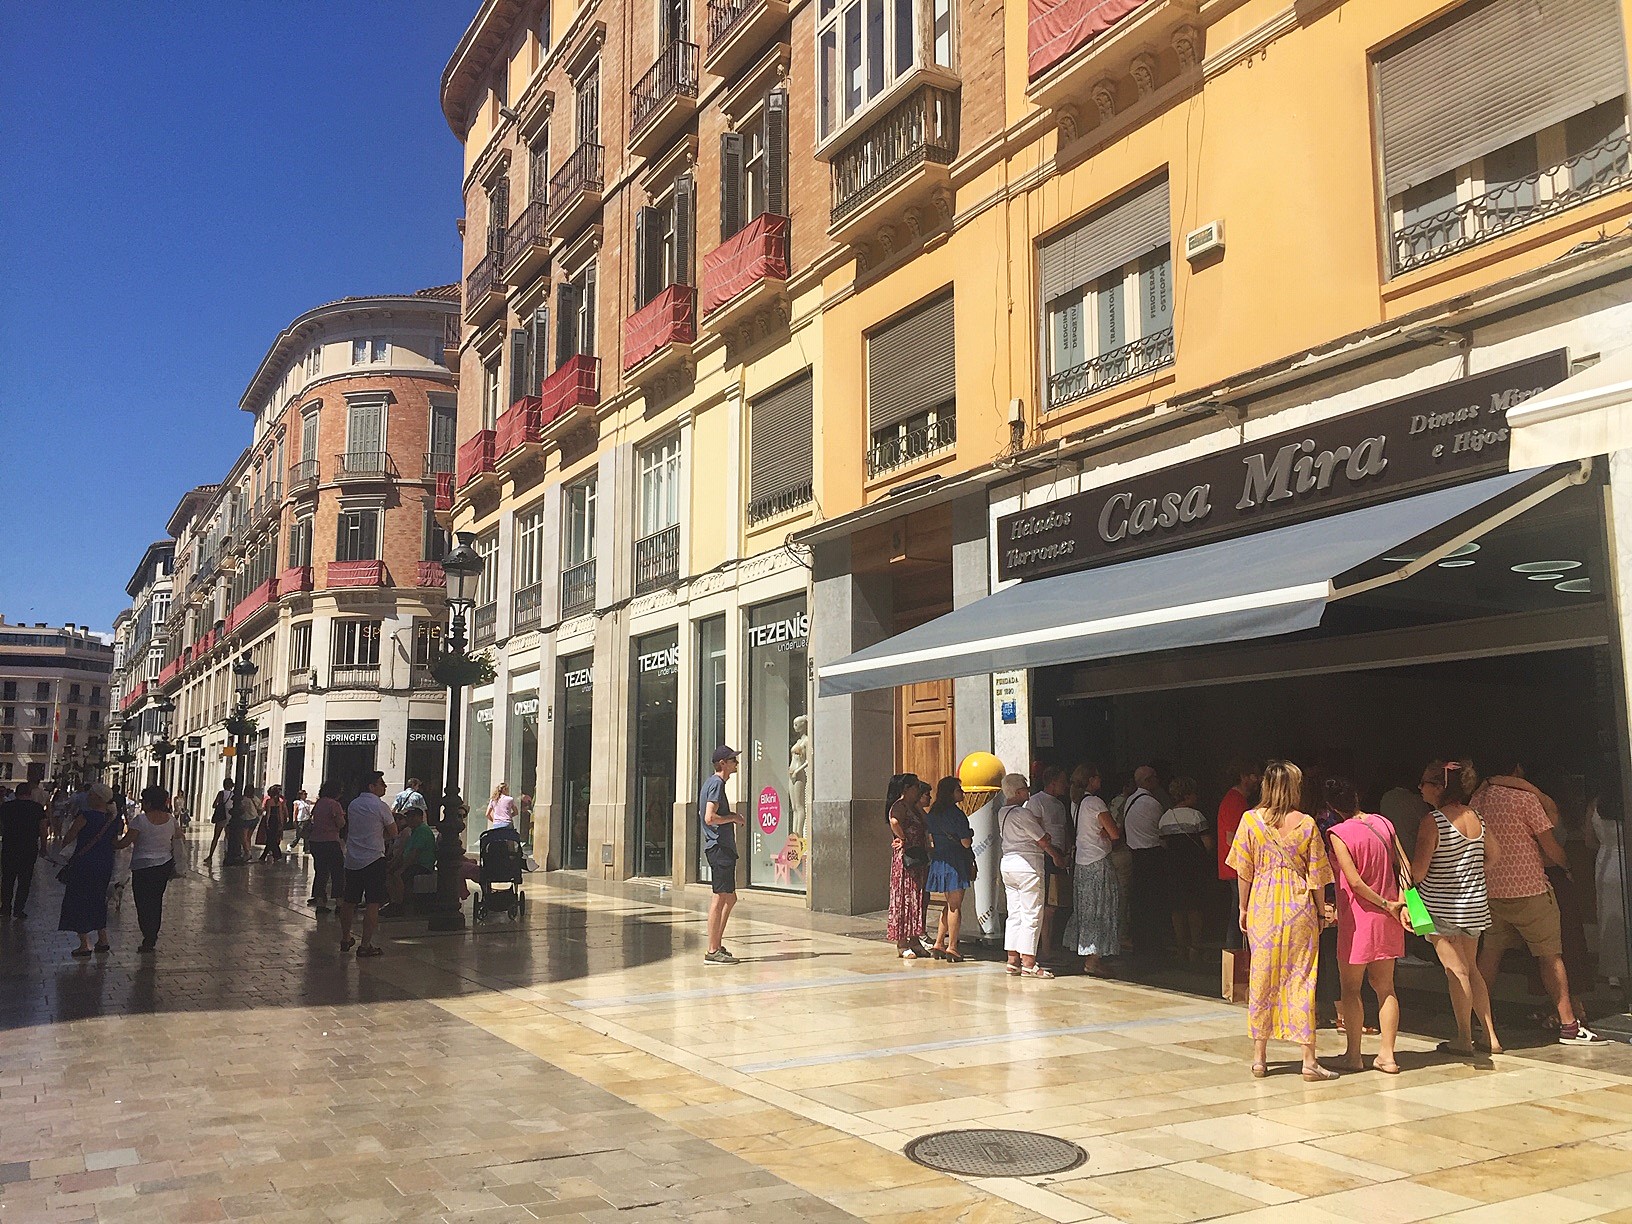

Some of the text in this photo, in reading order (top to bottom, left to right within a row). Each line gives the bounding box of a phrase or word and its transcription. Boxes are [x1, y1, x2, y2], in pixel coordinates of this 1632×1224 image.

[1409, 404, 1480, 435] Dimas
[1431, 427, 1509, 458] e Hijos
[1099, 434, 1388, 543] Casa Mira
[1009, 509, 1073, 540] Helados
[1006, 538, 1076, 569] Turrones
[565, 664, 594, 688] TEZEN
[325, 733, 377, 742] SPRINGFIELD
[760, 792, 777, 804] Bikini
